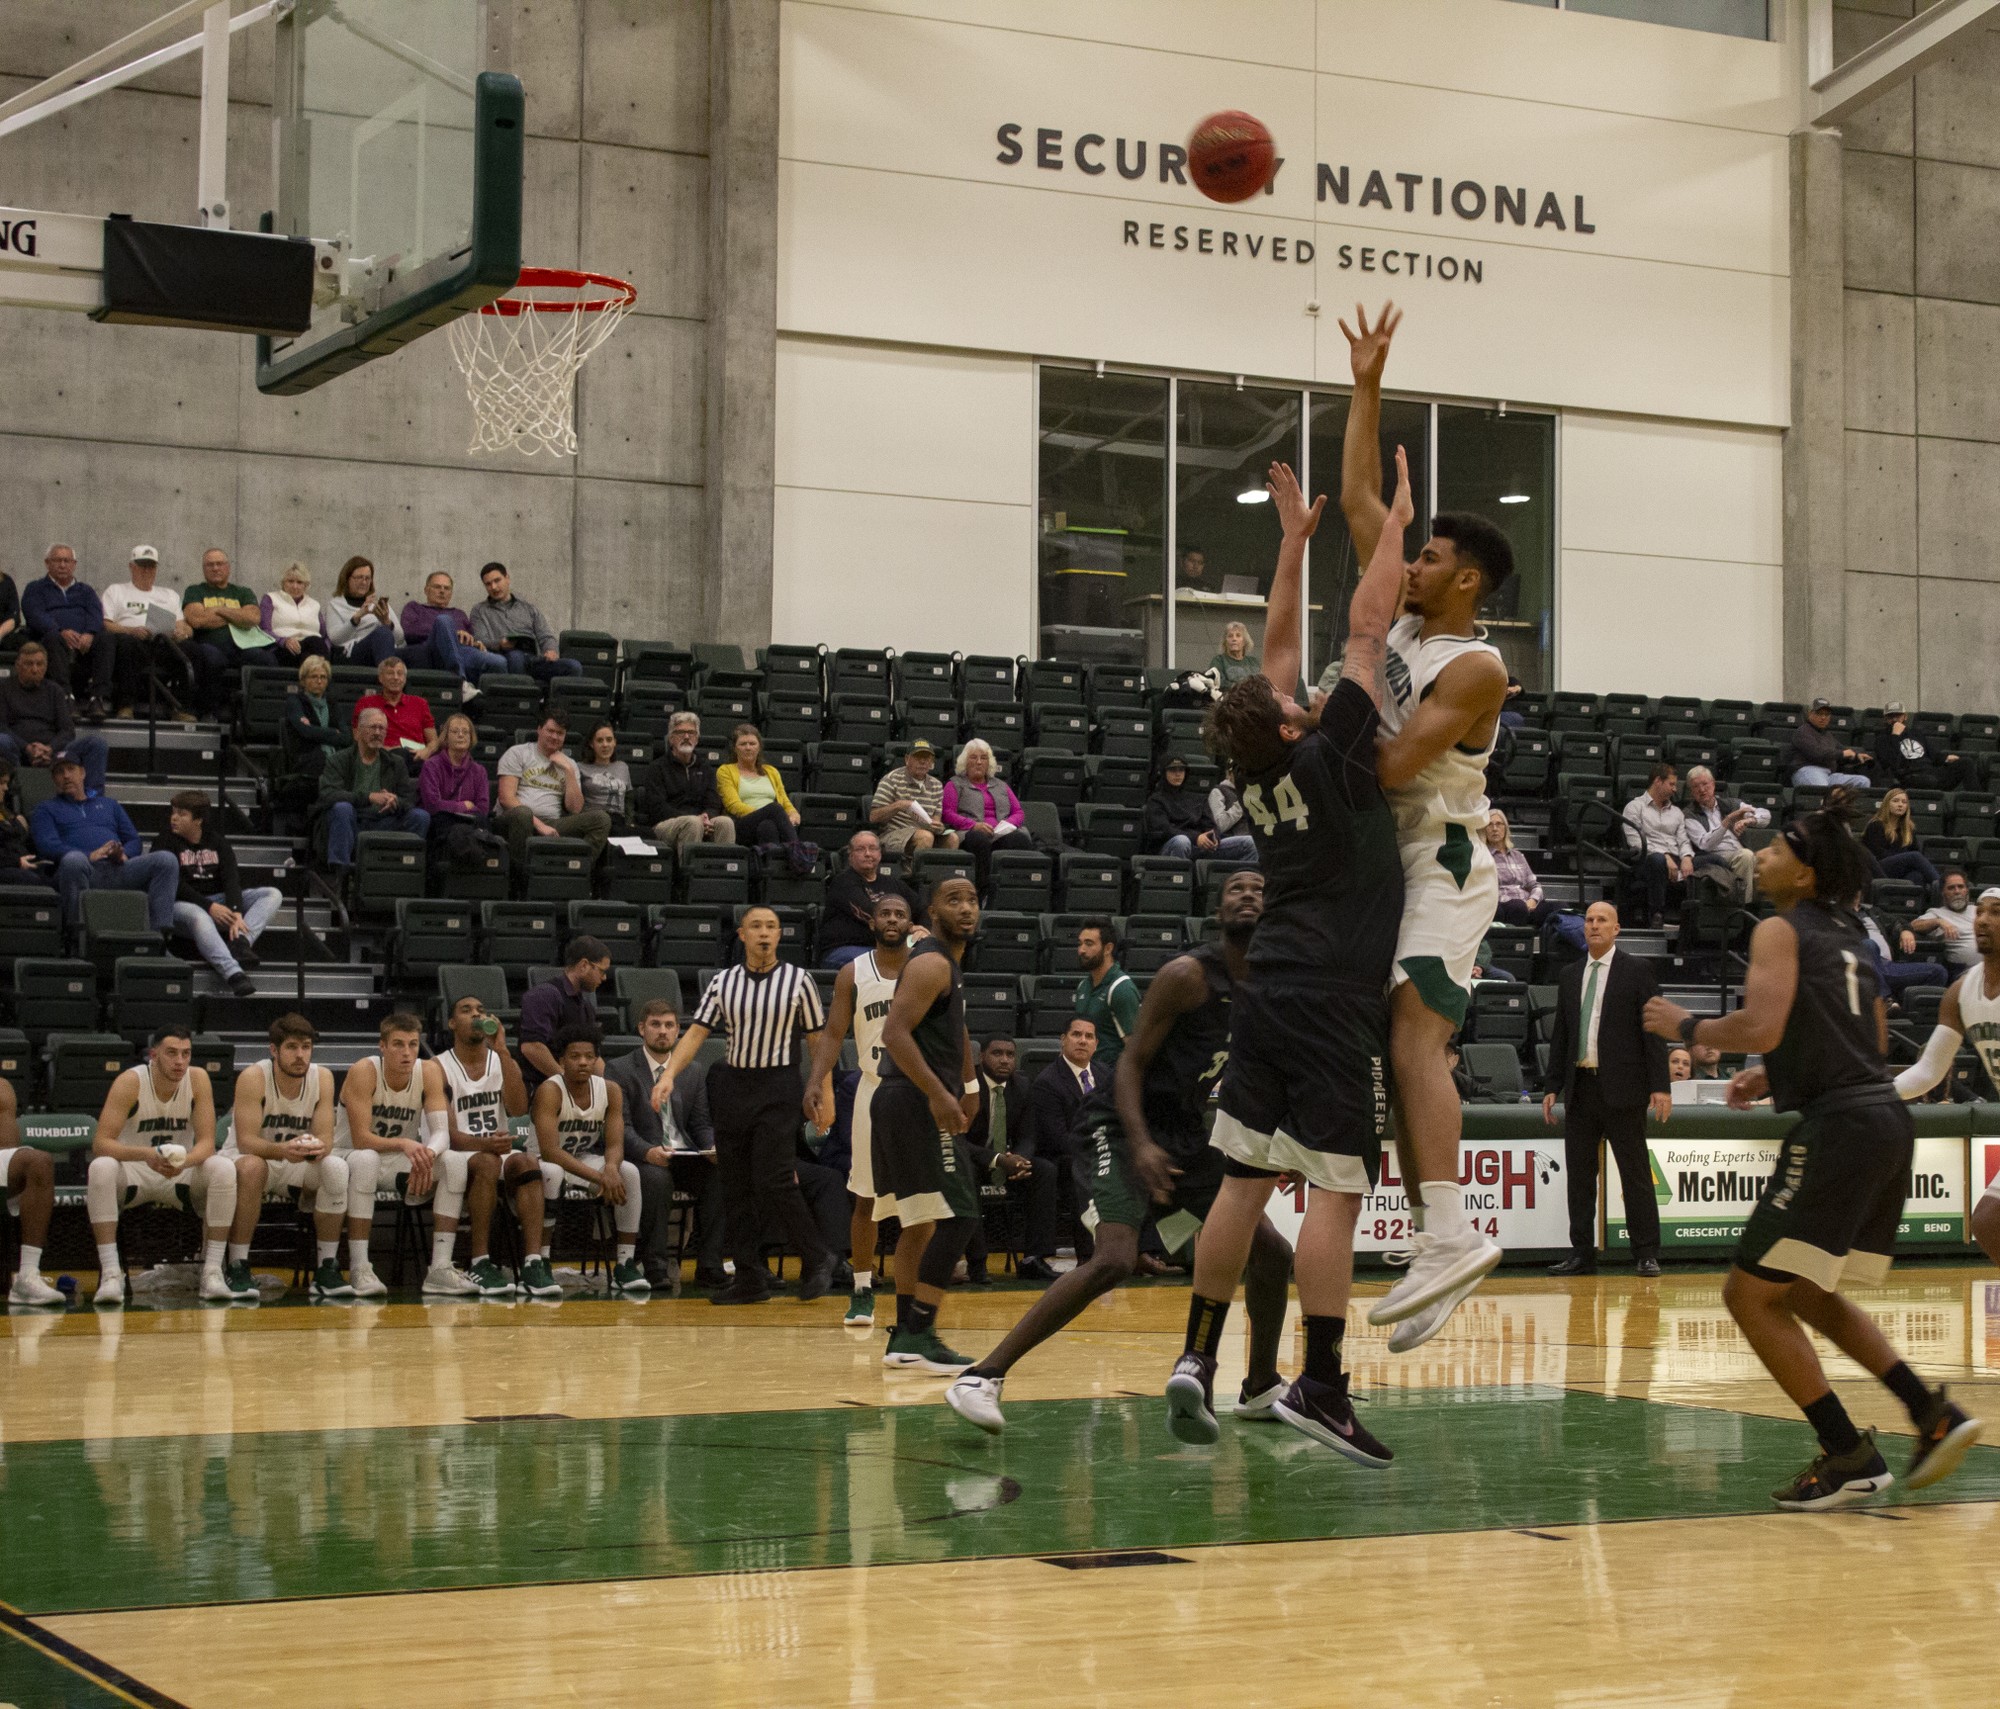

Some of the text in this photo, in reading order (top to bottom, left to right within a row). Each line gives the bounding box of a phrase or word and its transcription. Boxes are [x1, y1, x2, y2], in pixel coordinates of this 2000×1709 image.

[996, 122, 1596, 234] SECURY NATIONAL
[1123, 219, 1484, 284] RESERVED SECTION
[1243, 773, 1309, 836] 44
[26, 1126, 90, 1138] HUMBOLDT
[468, 1110, 498, 1132] 55
[1667, 1150, 1710, 1167] Roofing
[1713, 1150, 1756, 1167] Experts
[1678, 1170, 1772, 1203] McMur
[1464, 1194, 1500, 1210] INC.
[1675, 1228, 1729, 1238] CRESCENT
[1924, 1224, 1951, 1233] BEND
